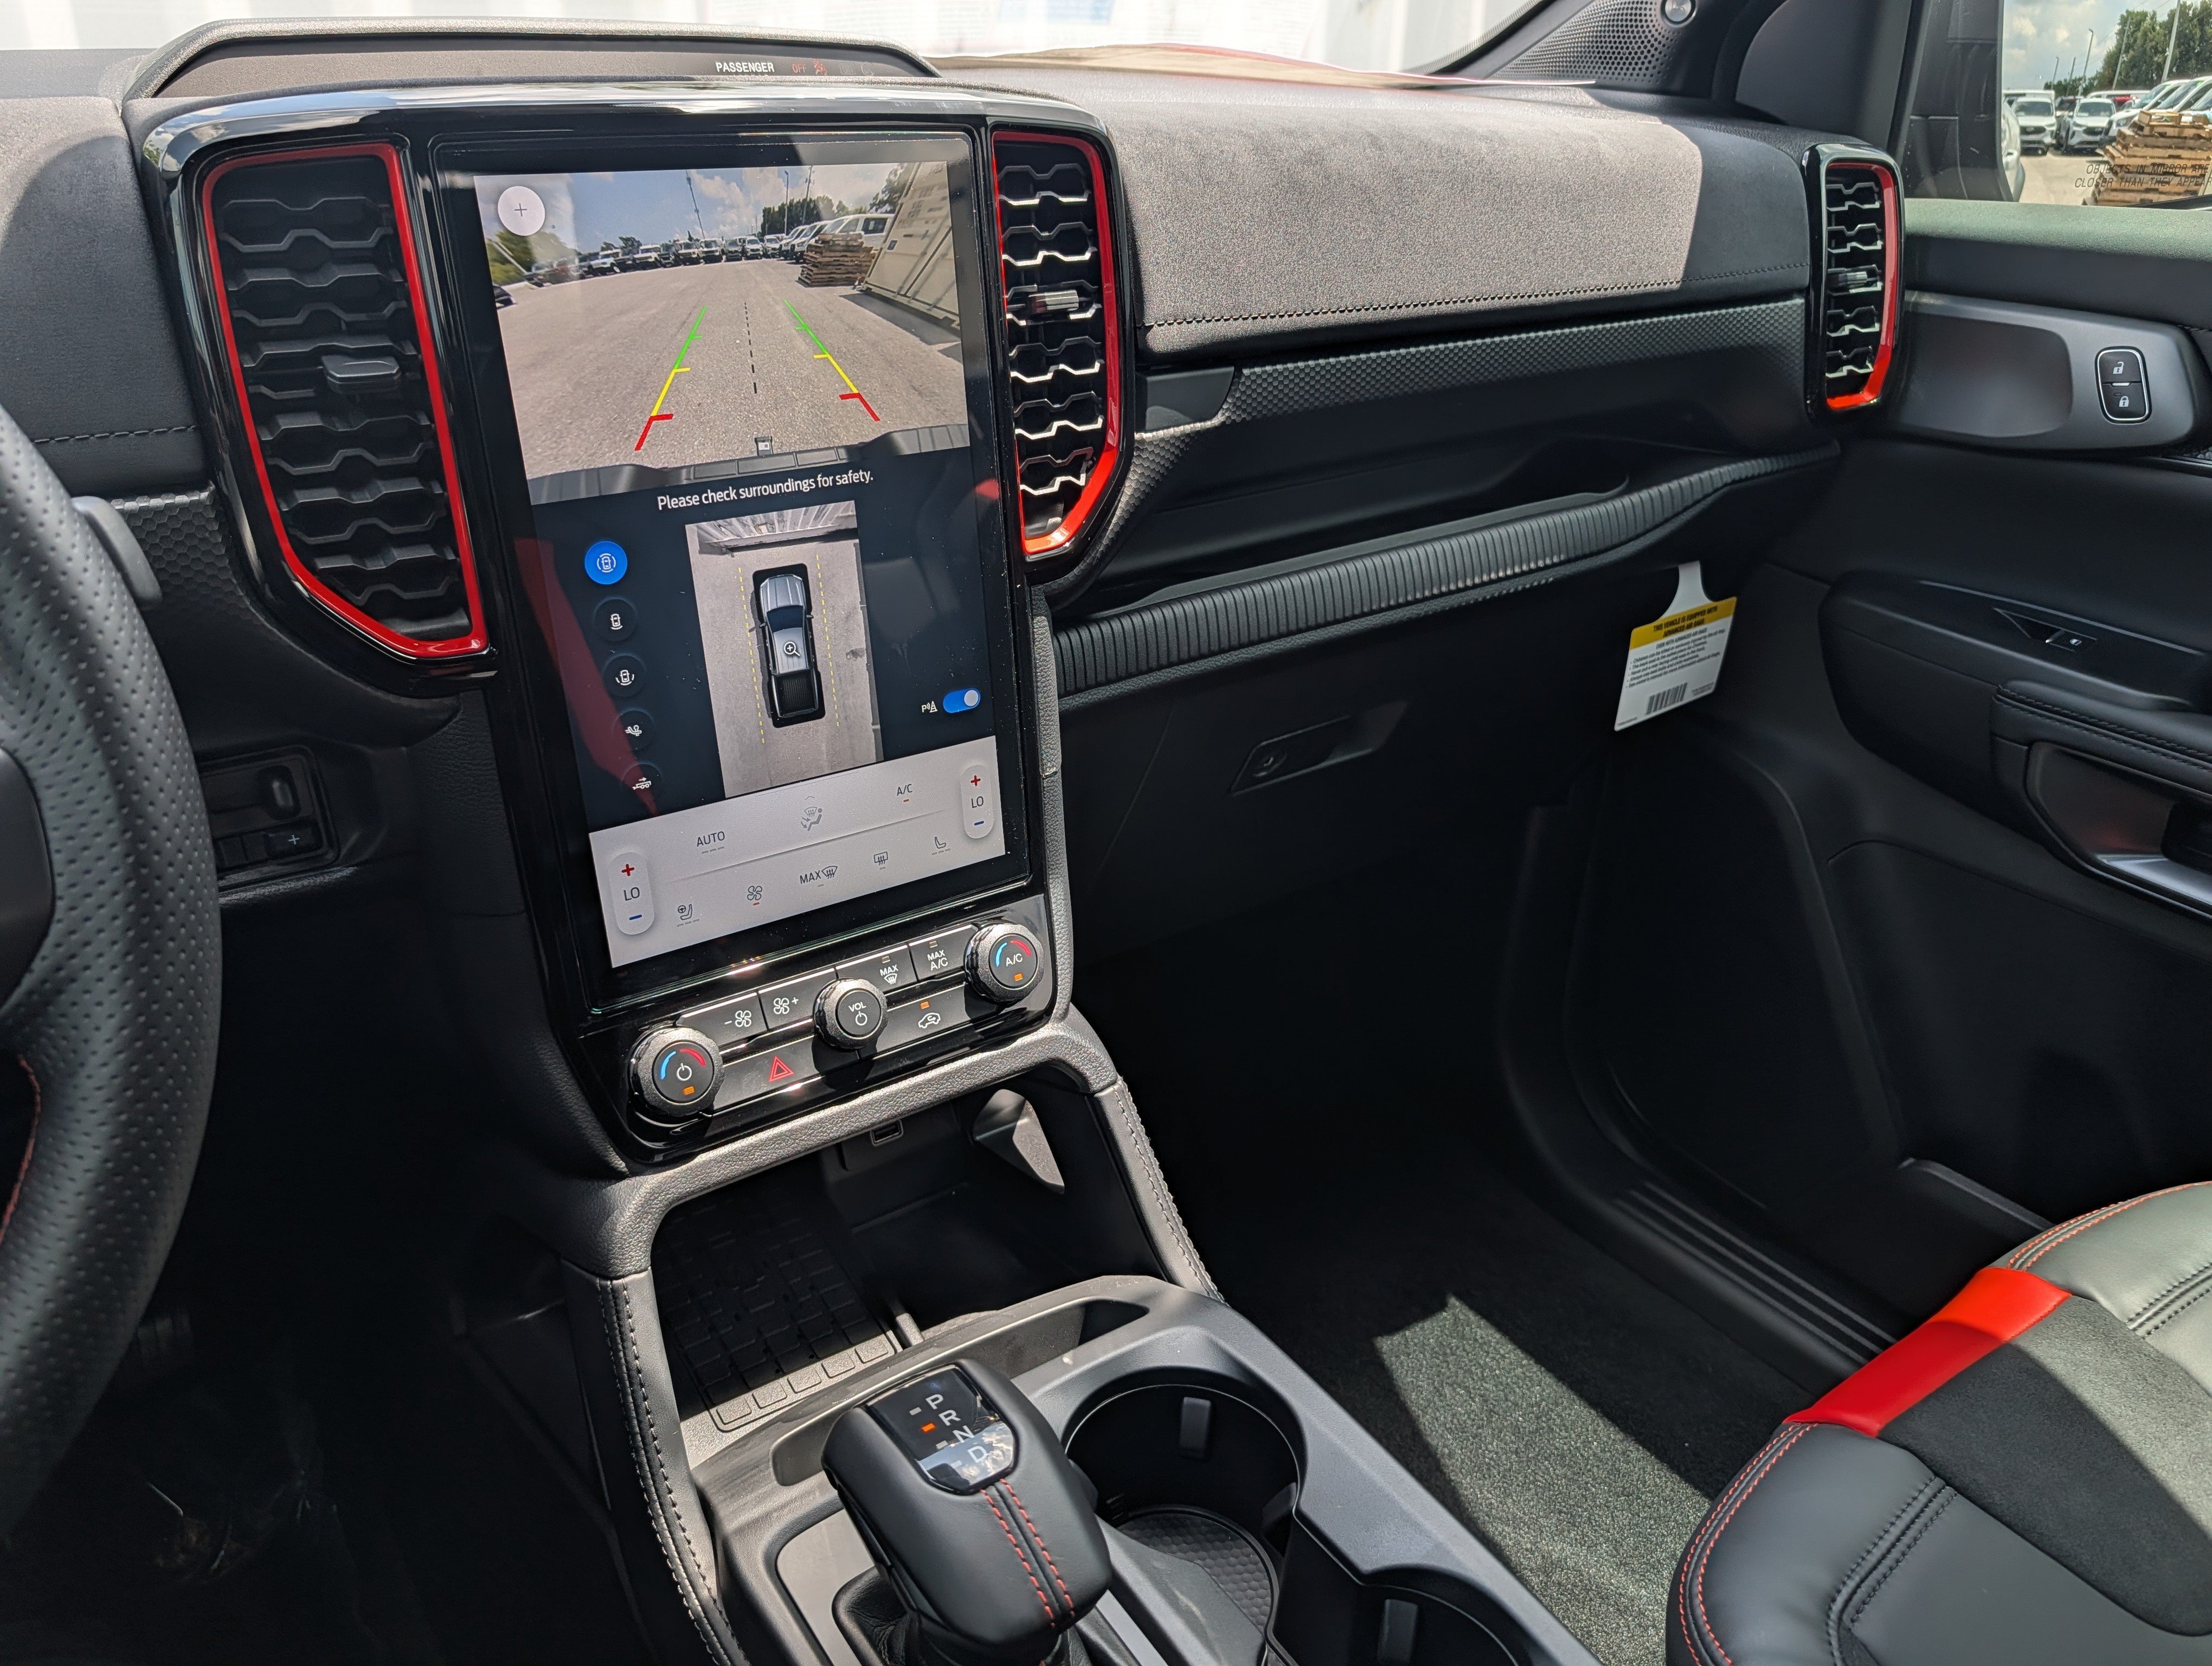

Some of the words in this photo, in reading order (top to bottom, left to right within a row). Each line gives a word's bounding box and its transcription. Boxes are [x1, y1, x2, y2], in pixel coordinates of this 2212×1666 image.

[715, 61, 775, 73] PASSENGER
[792, 63, 807, 73] OFF
[2086, 164, 2131, 174] OBJECTS
[2136, 164, 2145, 174] IN
[2151, 163, 2188, 174] MIRROR
[2190, 163, 2210, 174] ARE
[2074, 177, 2114, 188] CLOSER
[2119, 177, 2145, 187] THAN
[2150, 177, 2175, 188] THEY
[657, 492, 700, 510] Please
[701, 486, 737, 504] check
[739, 477, 814, 499] surroundings
[817, 473, 834, 489] for
[835, 469, 873, 487] safety.
[896, 784, 913, 796] A/C
[971, 796, 984, 809] LO
[697, 831, 725, 847] AUTO
[800, 870, 821, 885] MAX
[623, 887, 640, 901] LO
[927, 949, 946, 961] MAX
[1006, 953, 1023, 967] A/C
[879, 964, 899, 976] MAX
[930, 957, 948, 971] A/C
[848, 1001, 867, 1013] VOL
[925, 1394, 944, 1409] P
[938, 1409, 961, 1426] R
[952, 1425, 976, 1443] N
[967, 1445, 988, 1463] D
